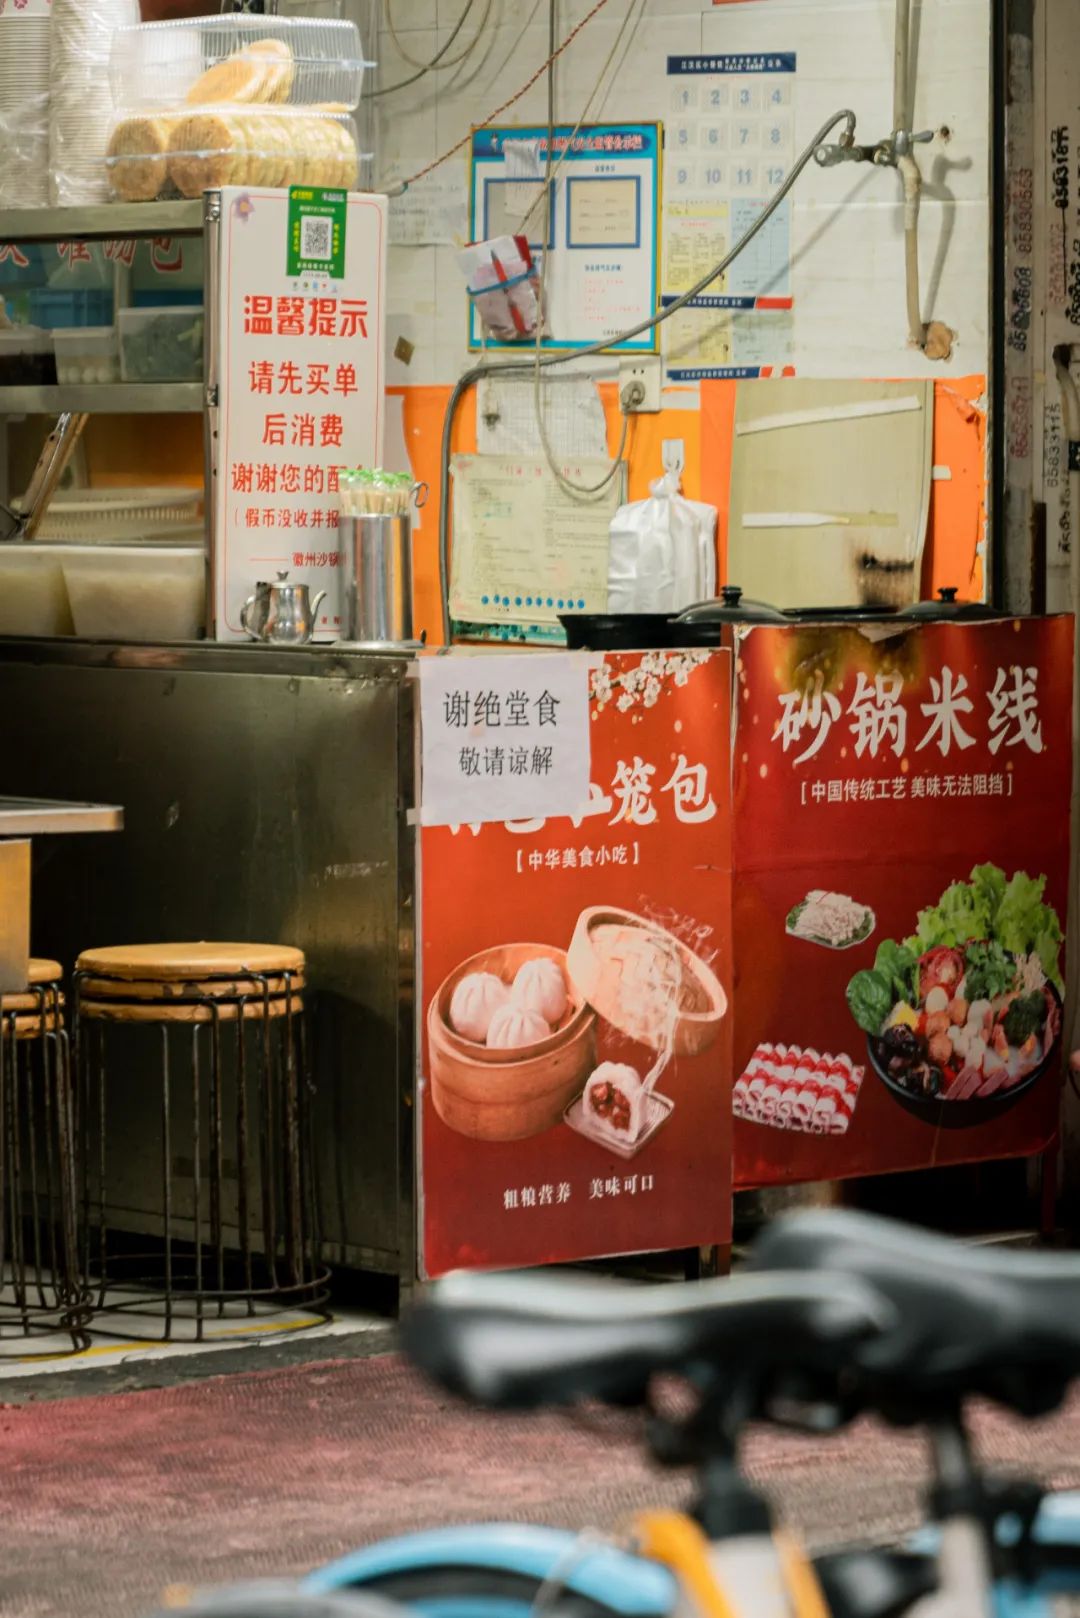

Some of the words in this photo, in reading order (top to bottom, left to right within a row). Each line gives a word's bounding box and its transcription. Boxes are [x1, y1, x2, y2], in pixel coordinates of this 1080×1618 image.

[706, 169, 721, 184] 10
[737, 169, 752, 183] 11
[767, 169, 784, 184] 12
[244, 295, 368, 338] 温馨提示
[248, 361, 358, 397] 请先买单
[262, 413, 344, 448] 后消费
[231, 463, 363, 494] 谢谢您的配
[443, 689, 561, 728] 谢绝堂食
[771, 665, 1043, 766] 砂锅米线
[459, 746, 553, 777] 敬请谅解
[503, 1182, 571, 1210] 粗粮营养
[589, 1174, 654, 1200] 美味可口
